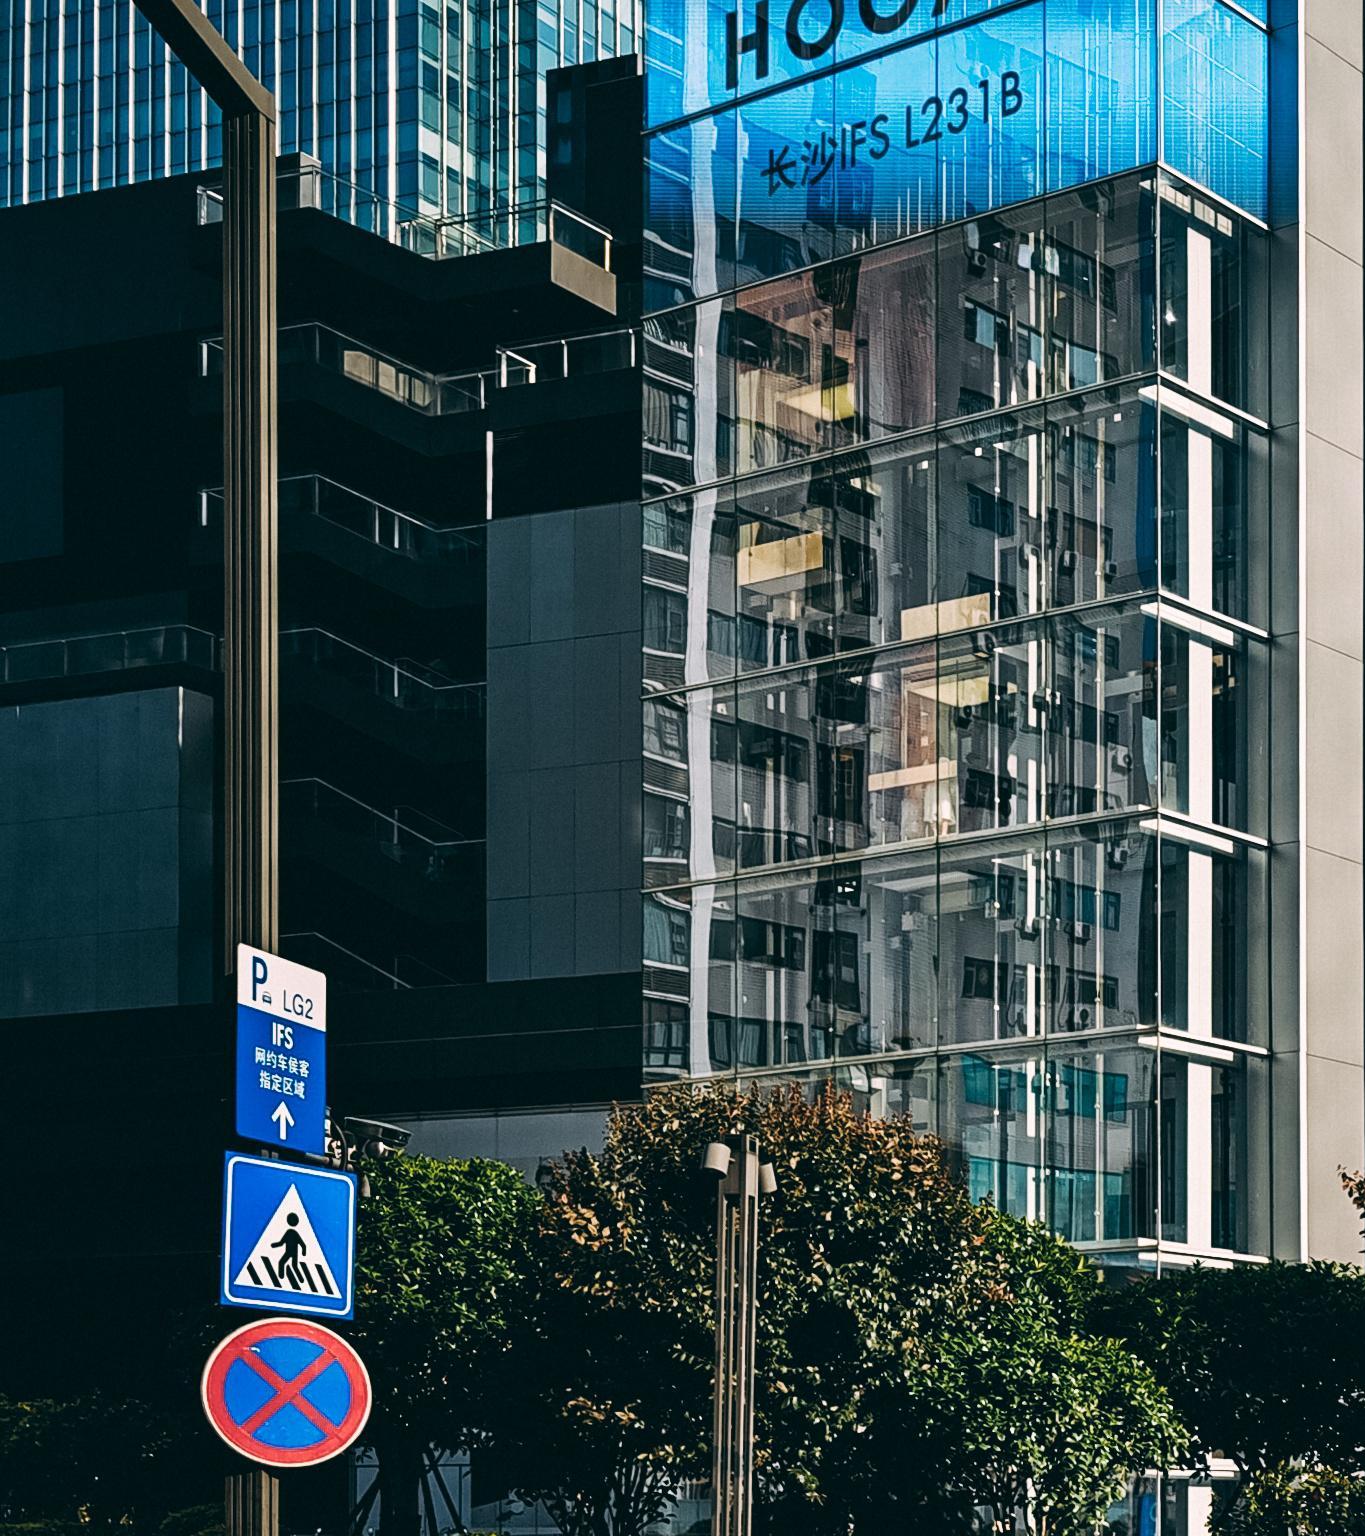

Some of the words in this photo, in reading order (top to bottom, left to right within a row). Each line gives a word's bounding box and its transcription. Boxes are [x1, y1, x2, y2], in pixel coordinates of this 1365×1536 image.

[761, 114, 889, 197] 长沙IFS
[906, 71, 1022, 148] L231B
[252, 956, 268, 1002] P
[283, 990, 314, 1020] LG2
[272, 1022, 294, 1050] IFS
[259, 1070, 305, 1099] 指定区域
